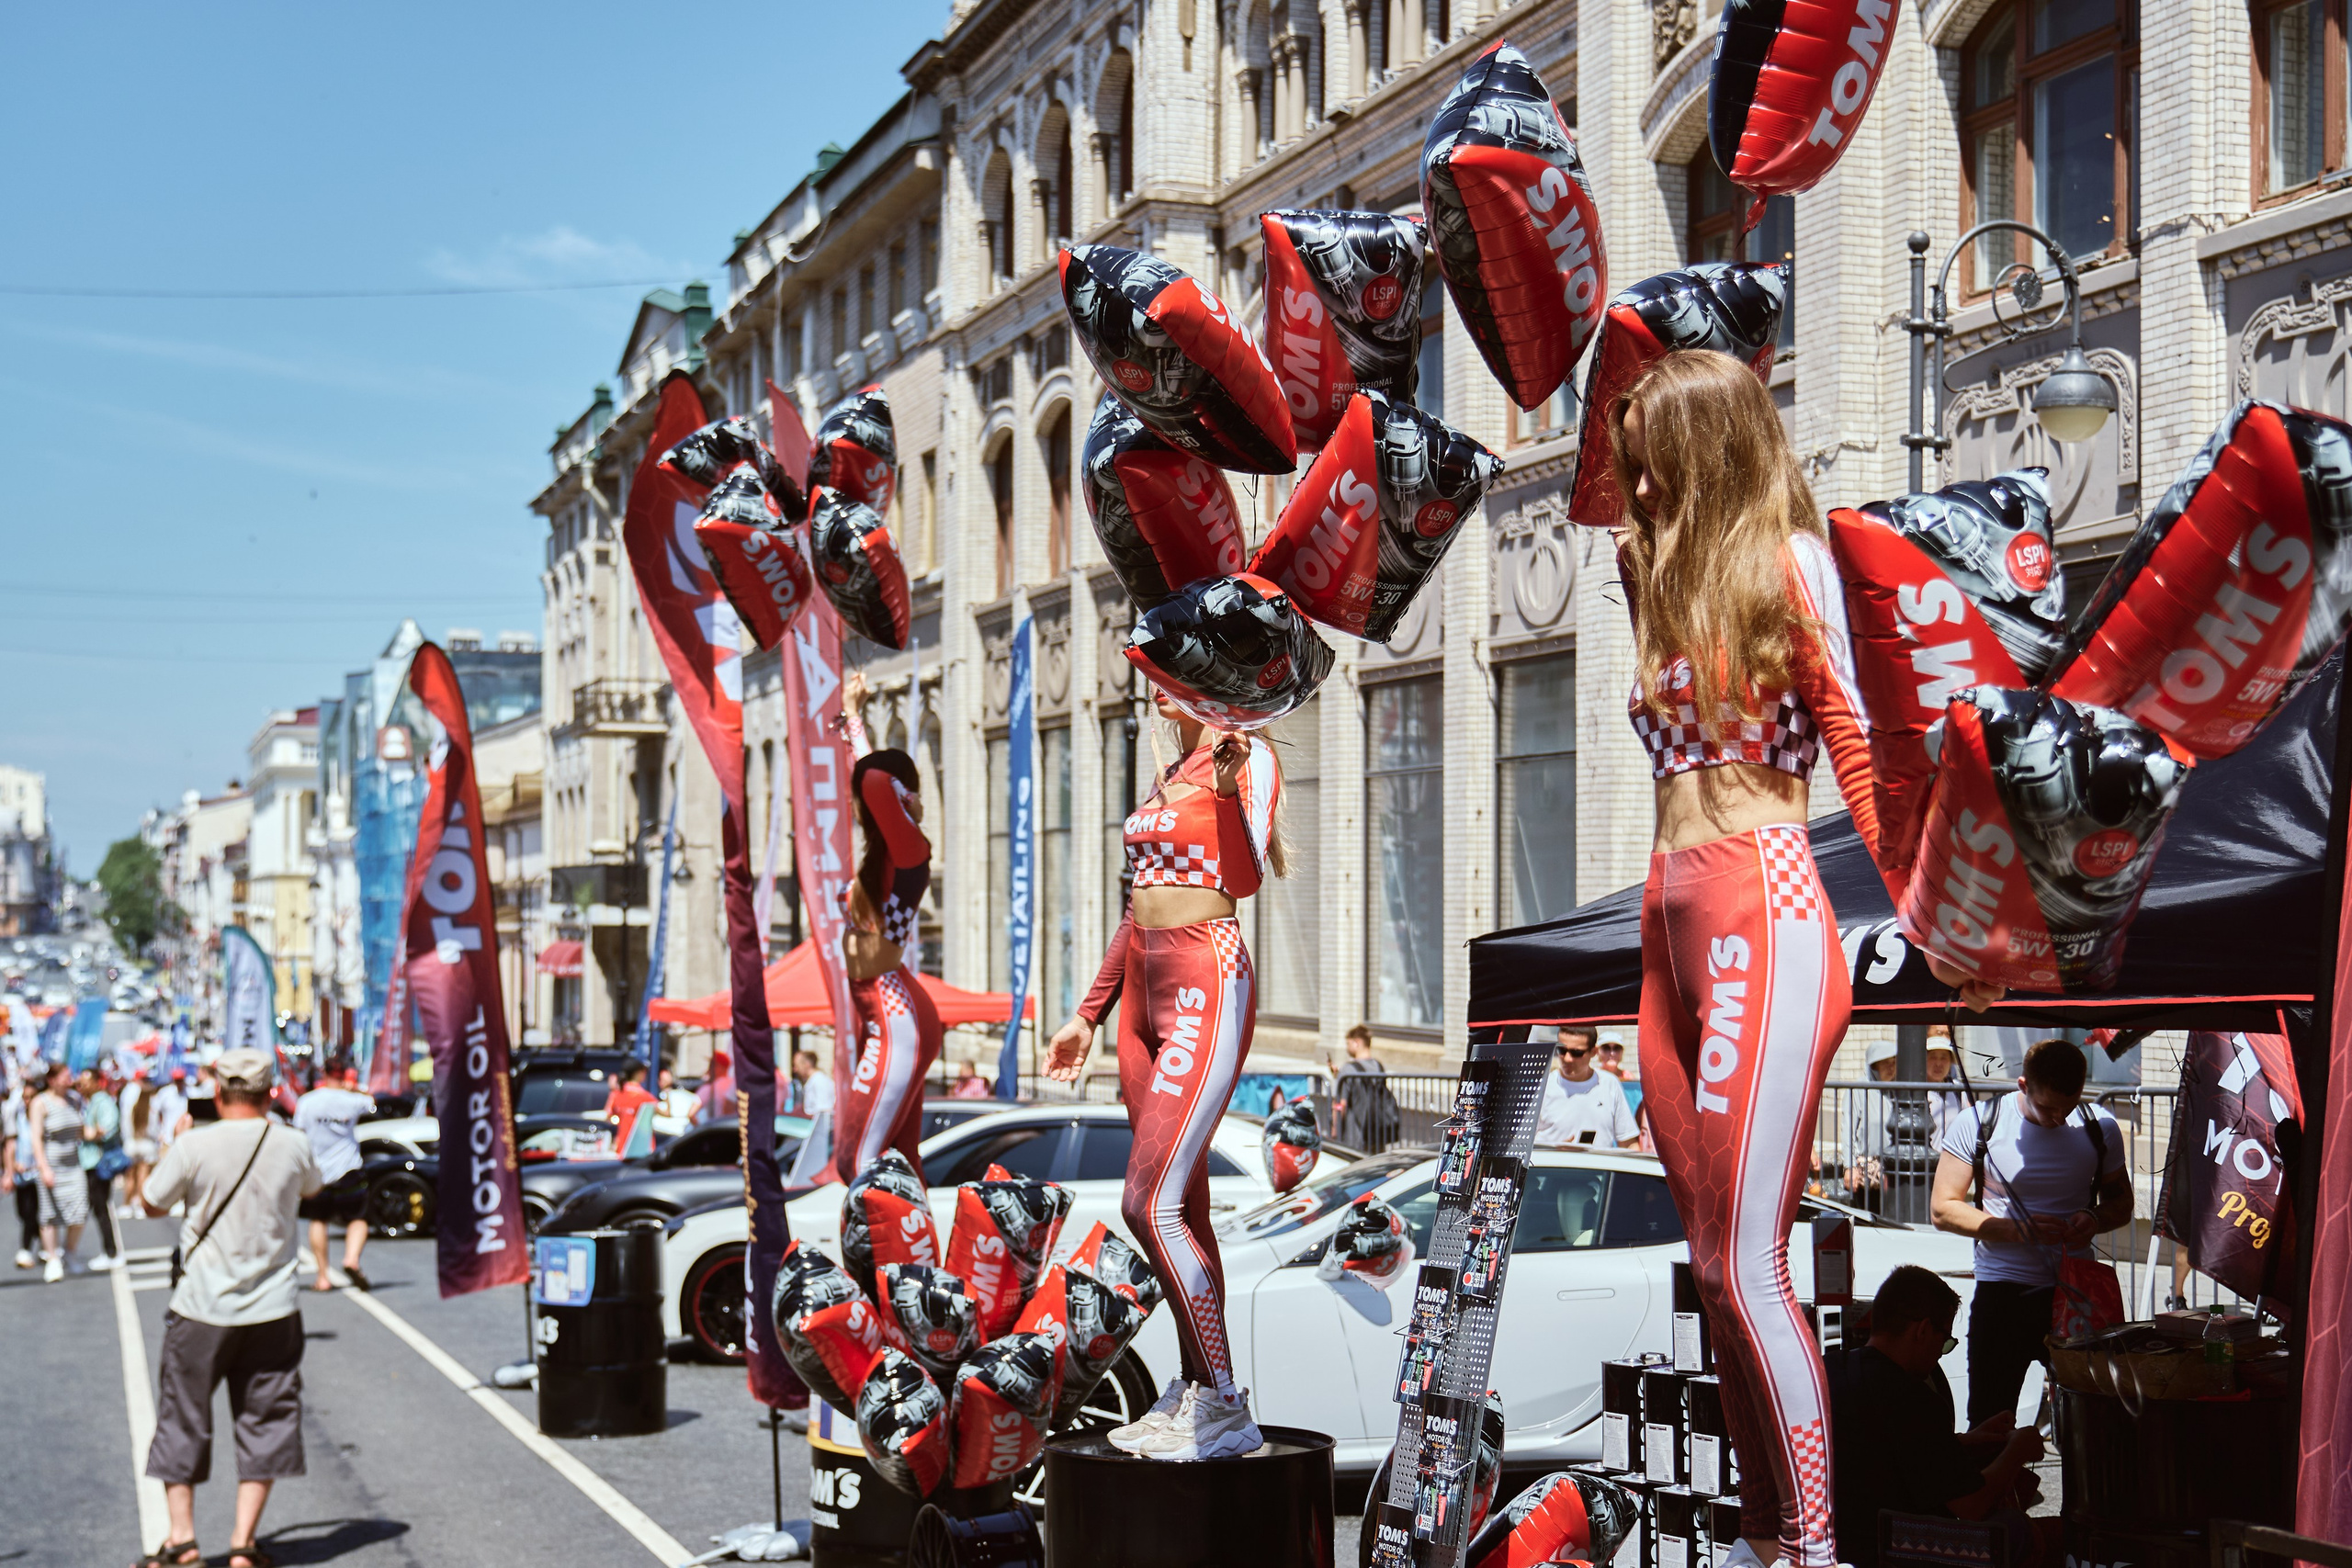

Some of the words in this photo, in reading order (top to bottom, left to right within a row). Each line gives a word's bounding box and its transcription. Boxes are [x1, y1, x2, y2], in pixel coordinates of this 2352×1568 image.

[1526, 167, 1599, 350] TOM'S
[1373, 287, 1396, 301] LSPI
[1120, 367, 1142, 379] LSPI
[864, 462, 888, 518] M'S
[1428, 507, 1453, 523] LSPI
[1176, 459, 1241, 574] OM'S
[1279, 468, 1377, 607] TOM'S
[1350, 572, 1409, 591] PROFESSIONAL
[2015, 545, 2045, 567] LSPI
[2025, 564, 2042, 579] 対応
[2122, 521, 2311, 732] TOM'S
[1264, 659, 1286, 679] LSPI
[1892, 579, 1975, 766] M'S
[2091, 840, 2130, 857] LSPI
[1930, 807, 2014, 970] TOM'S
[2012, 927, 2102, 943] PROFESSIONAL
[465, 1004, 489, 1080] OIL
[1152, 986, 1207, 1098] TOM'S
[1697, 933, 1749, 1114] TOM'S
[469, 1089, 505, 1255] MOTOR
[1480, 1195, 1498, 1203] MOTOR
[900, 1209, 936, 1268] M'S
[971, 1234, 1006, 1314] OM'S
[846, 1302, 882, 1354] M'S
[1417, 1303, 1434, 1314] MOTOR
[986, 1411, 1022, 1482] TOM'S
[1426, 1433, 1445, 1445] MOTOR
[810, 1466, 862, 1509] M'S
[1378, 1542, 1396, 1553] MOTOR
